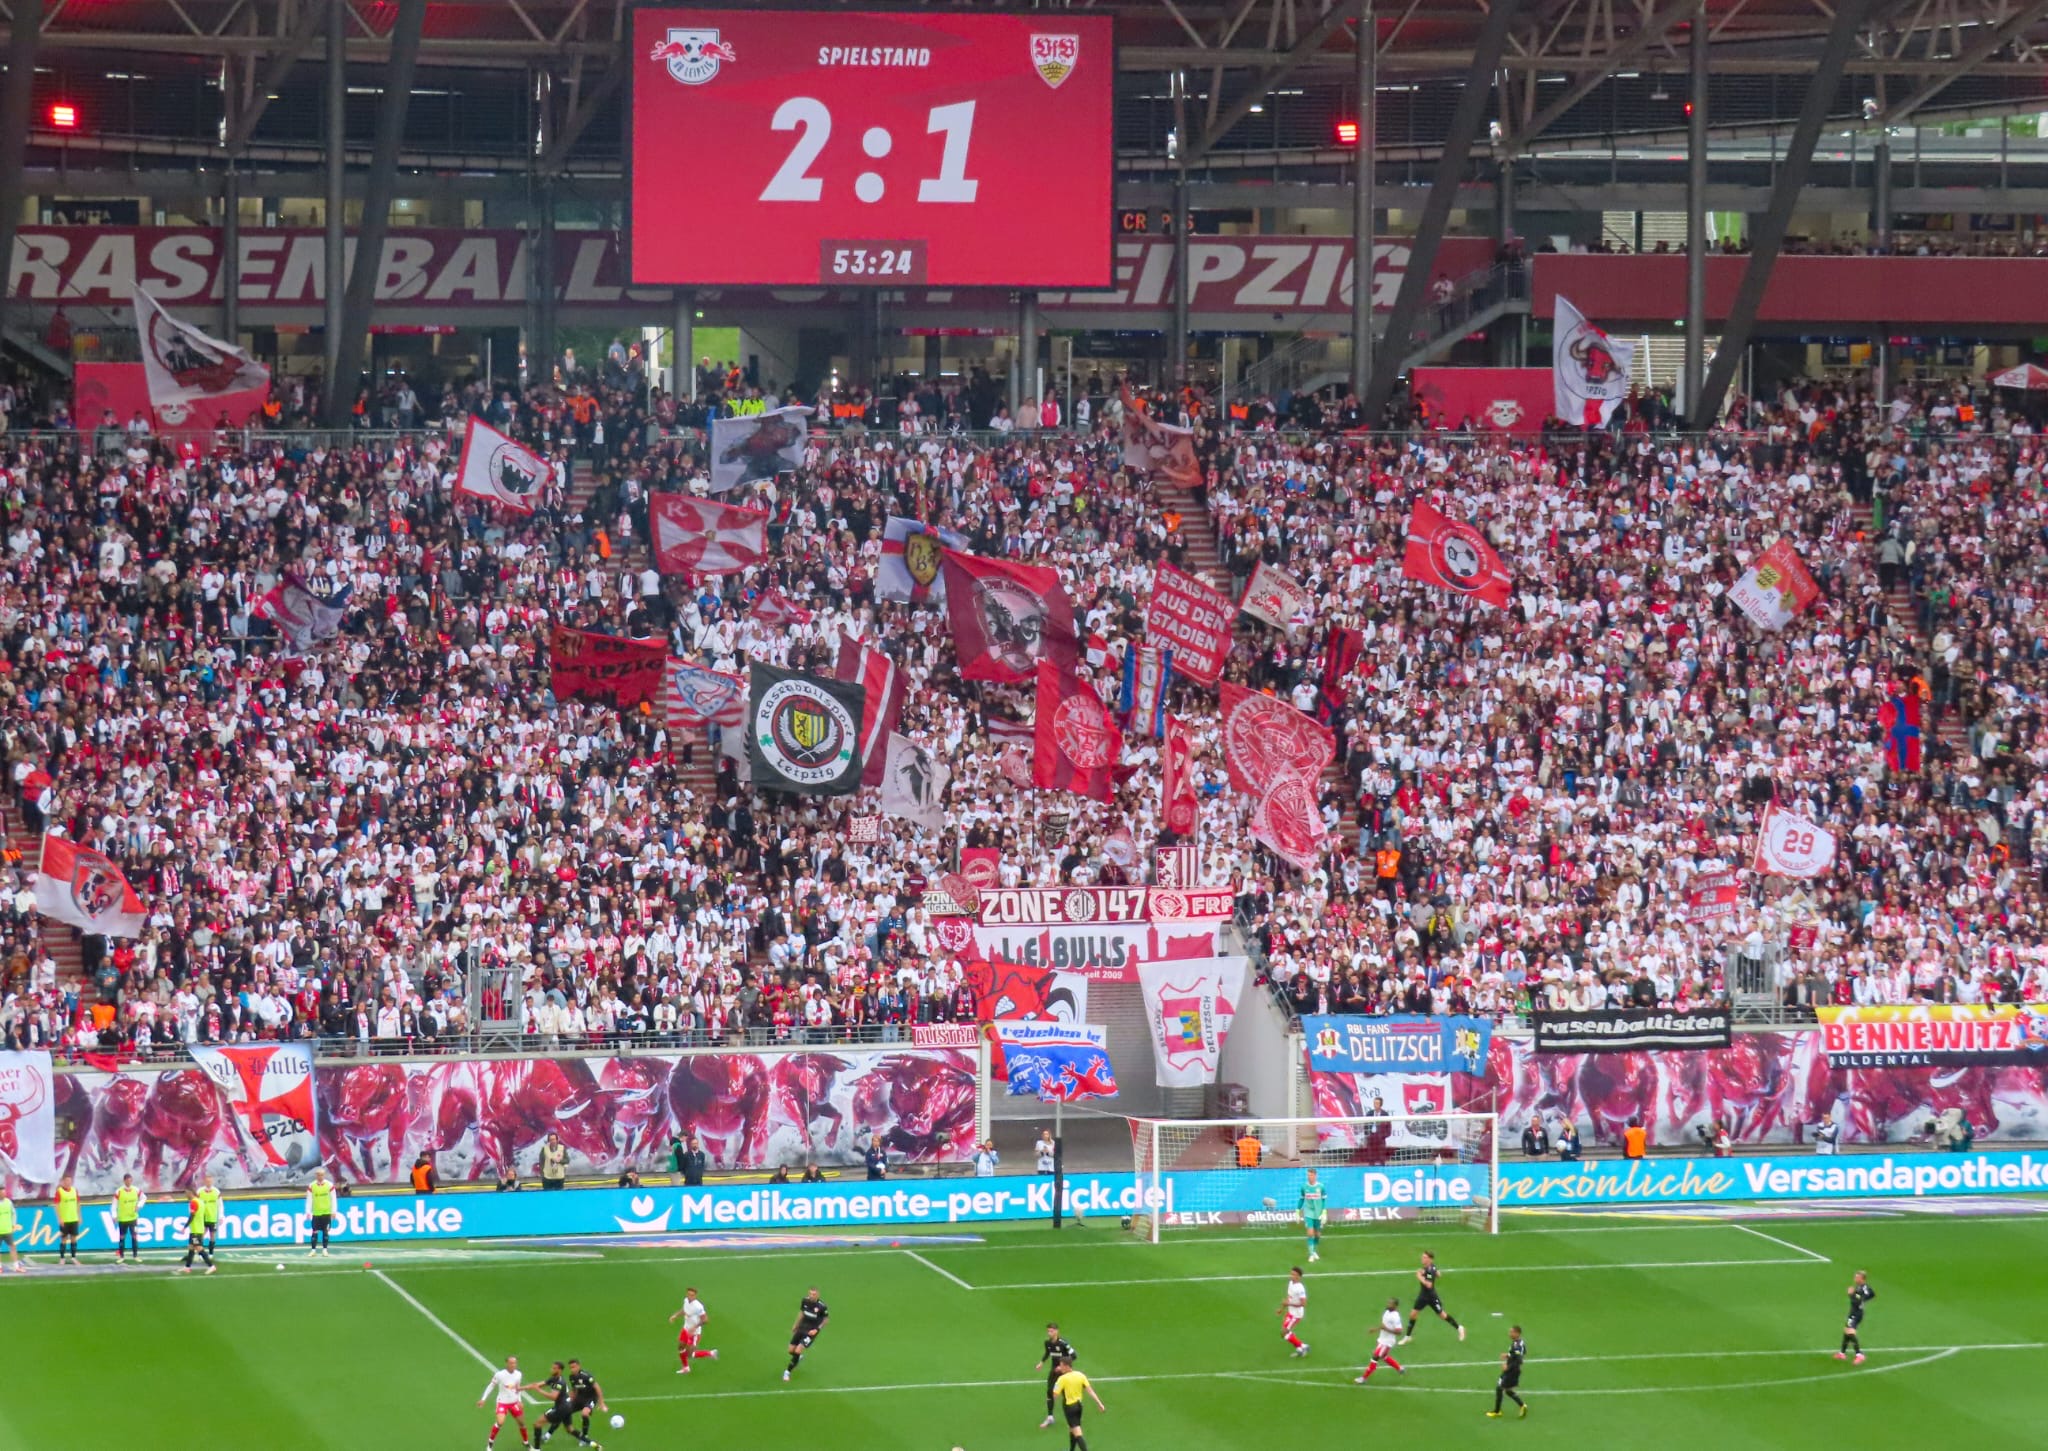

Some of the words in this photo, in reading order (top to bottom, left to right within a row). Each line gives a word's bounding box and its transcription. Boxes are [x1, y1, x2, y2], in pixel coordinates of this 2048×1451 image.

[818, 47, 931, 66] SPIELSTAND
[759, 96, 832, 202] 2
[917, 99, 979, 203] 1
[833, 248, 913, 275] 53:24
[1158, 568, 1236, 620] SEXISMUS
[1155, 591, 1190, 616] AUS
[1191, 605, 1226, 633] DEN
[1150, 610, 1218, 653] STADIEN
[776, 758, 835, 781] Leipzig
[1783, 829, 1815, 855] 29
[980, 890, 1062, 923] ZONE
[1098, 888, 1147, 922] 147
[1192, 895, 1233, 915] FRP
[1052, 936, 1127, 969] BULLS
[1102, 969, 1123, 979] 2009
[1202, 994, 1217, 1054] DELITZSCH
[1346, 1024, 1366, 1034] RBL
[1366, 1023, 1391, 1034] FANS
[1540, 1014, 1726, 1034] rasenballisten
[1823, 1020, 2014, 1052] BENNEWITZ
[1349, 1034, 1442, 1062] DELITZSCH
[249, 1057, 311, 1076] Bulls
[1363, 1169, 1471, 1204] Deine
[1179, 1211, 1223, 1225] ELK
[1358, 1206, 1402, 1220] ELK
